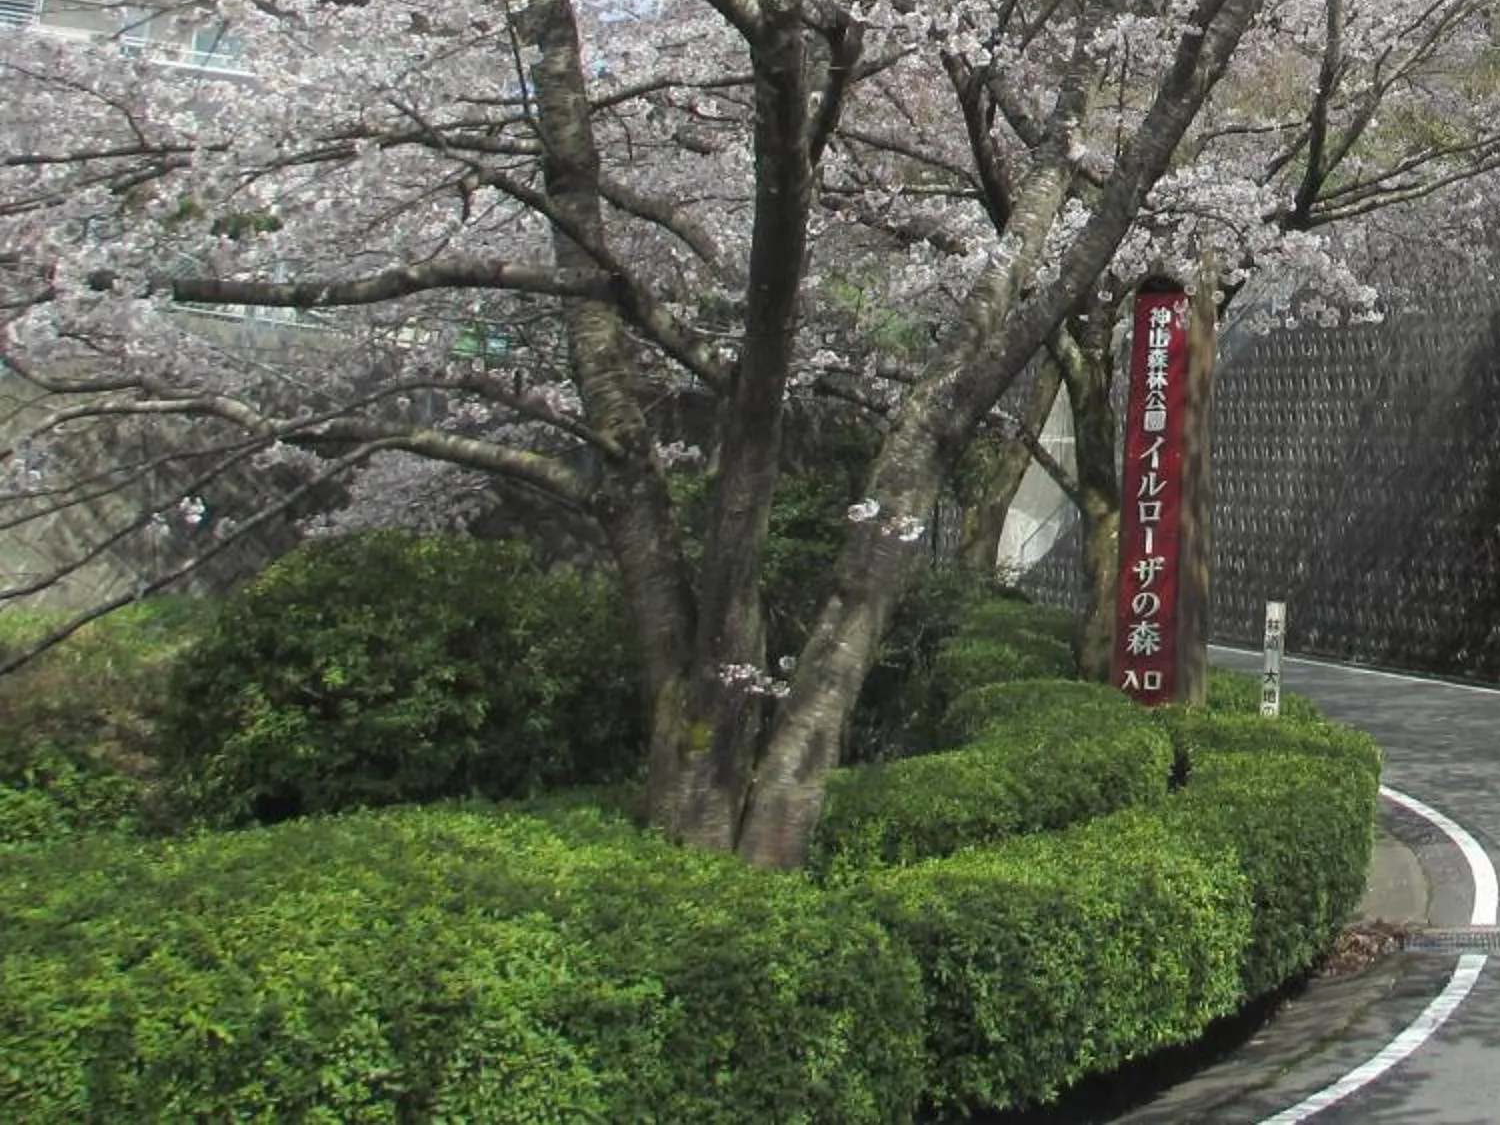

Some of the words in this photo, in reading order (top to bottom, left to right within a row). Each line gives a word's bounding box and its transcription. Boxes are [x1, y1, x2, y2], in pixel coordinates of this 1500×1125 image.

[1143, 306, 1172, 432] 神山森林公園
[1126, 436, 1166, 657] イルローザの森
[1121, 669, 1162, 691] 入口
